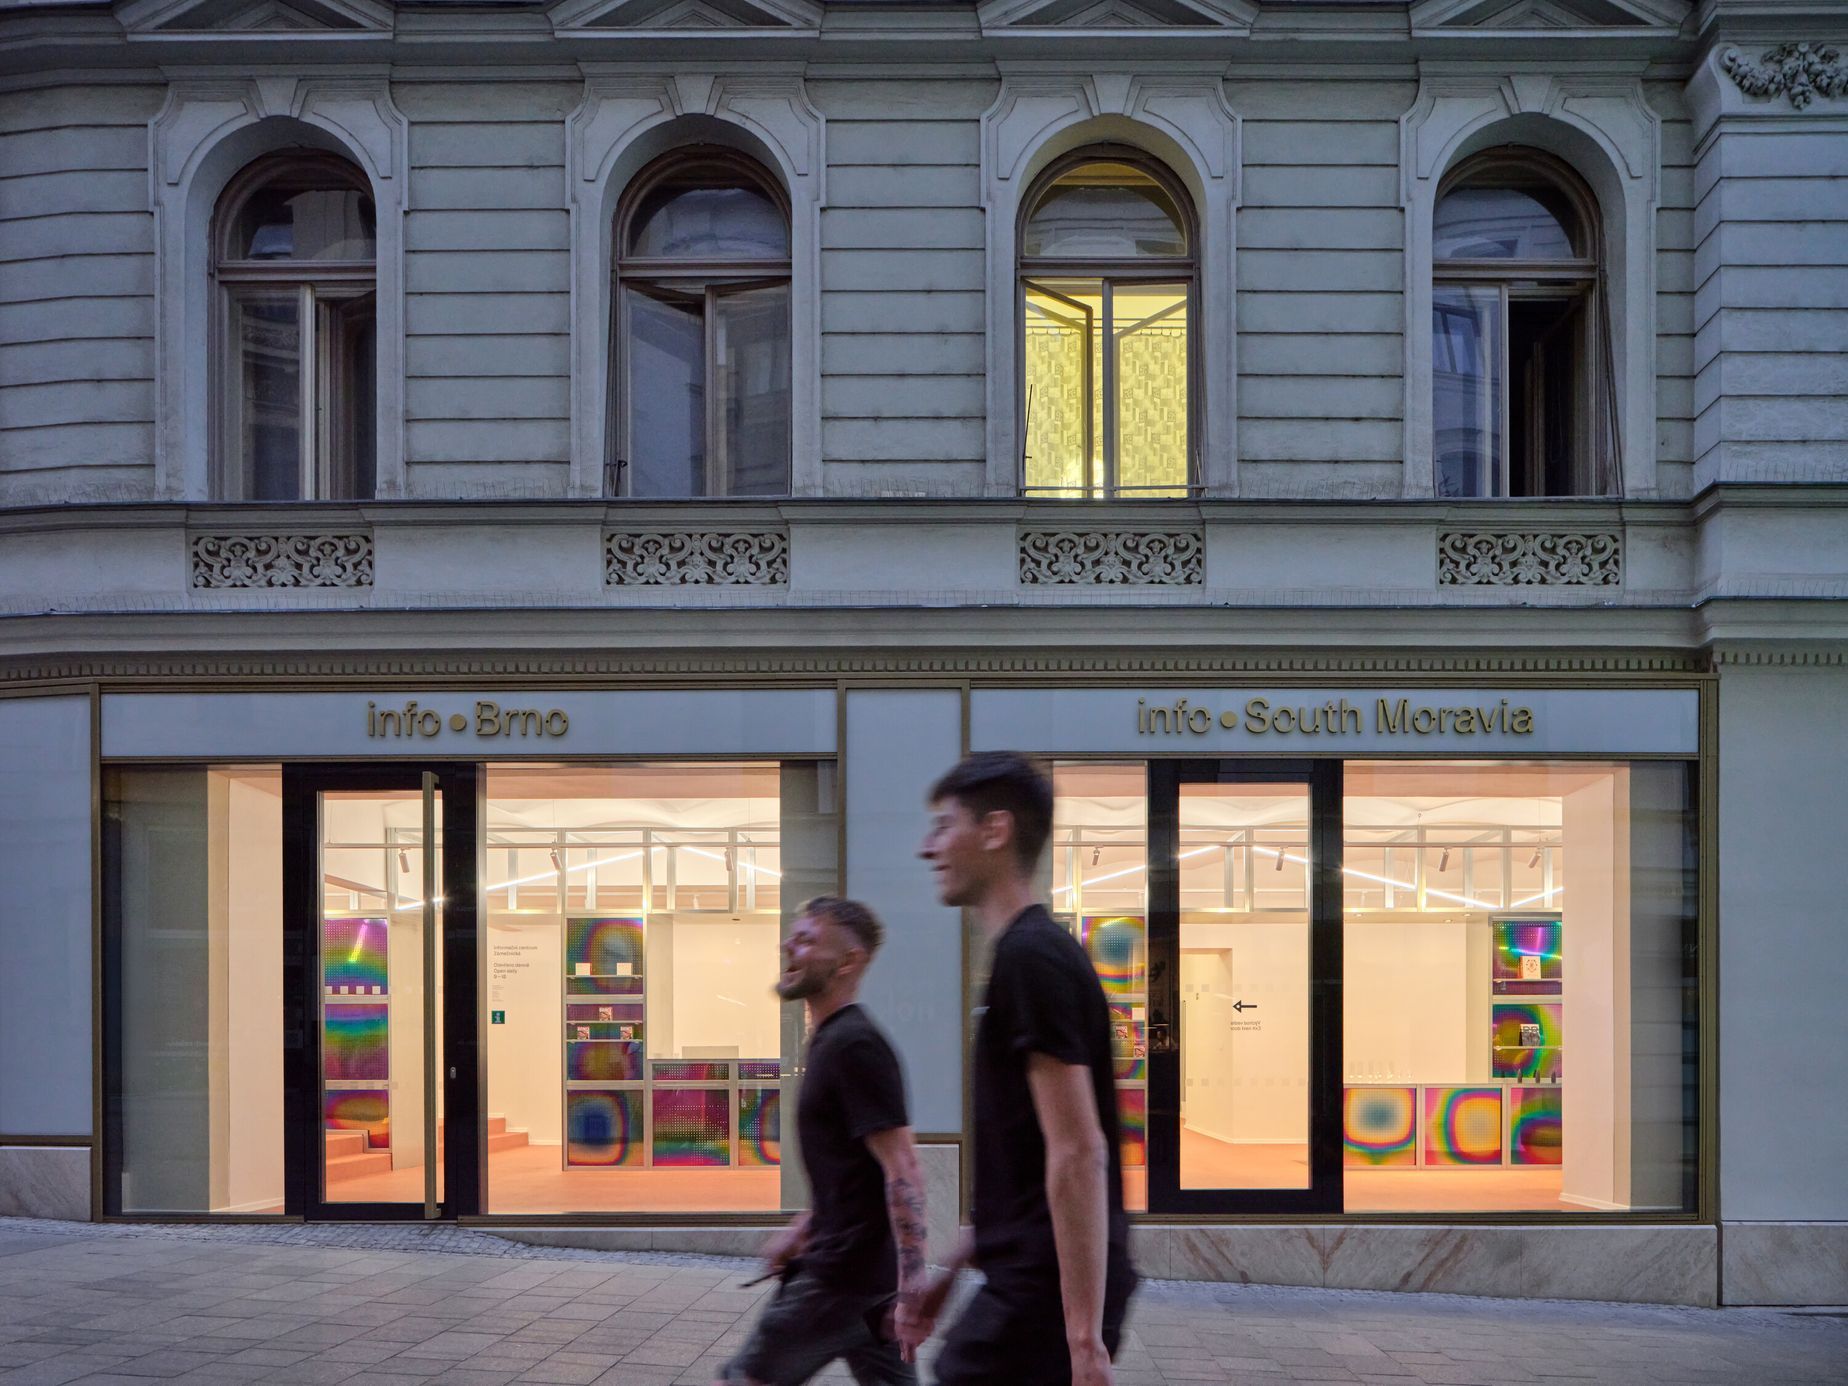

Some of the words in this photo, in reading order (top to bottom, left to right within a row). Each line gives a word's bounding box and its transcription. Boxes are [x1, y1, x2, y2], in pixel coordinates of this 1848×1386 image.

[367, 700, 441, 737] info
[475, 700, 569, 737] Brno
[1137, 696, 1212, 734] info
[1244, 696, 1363, 734] South
[1376, 697, 1535, 734] Moravia
